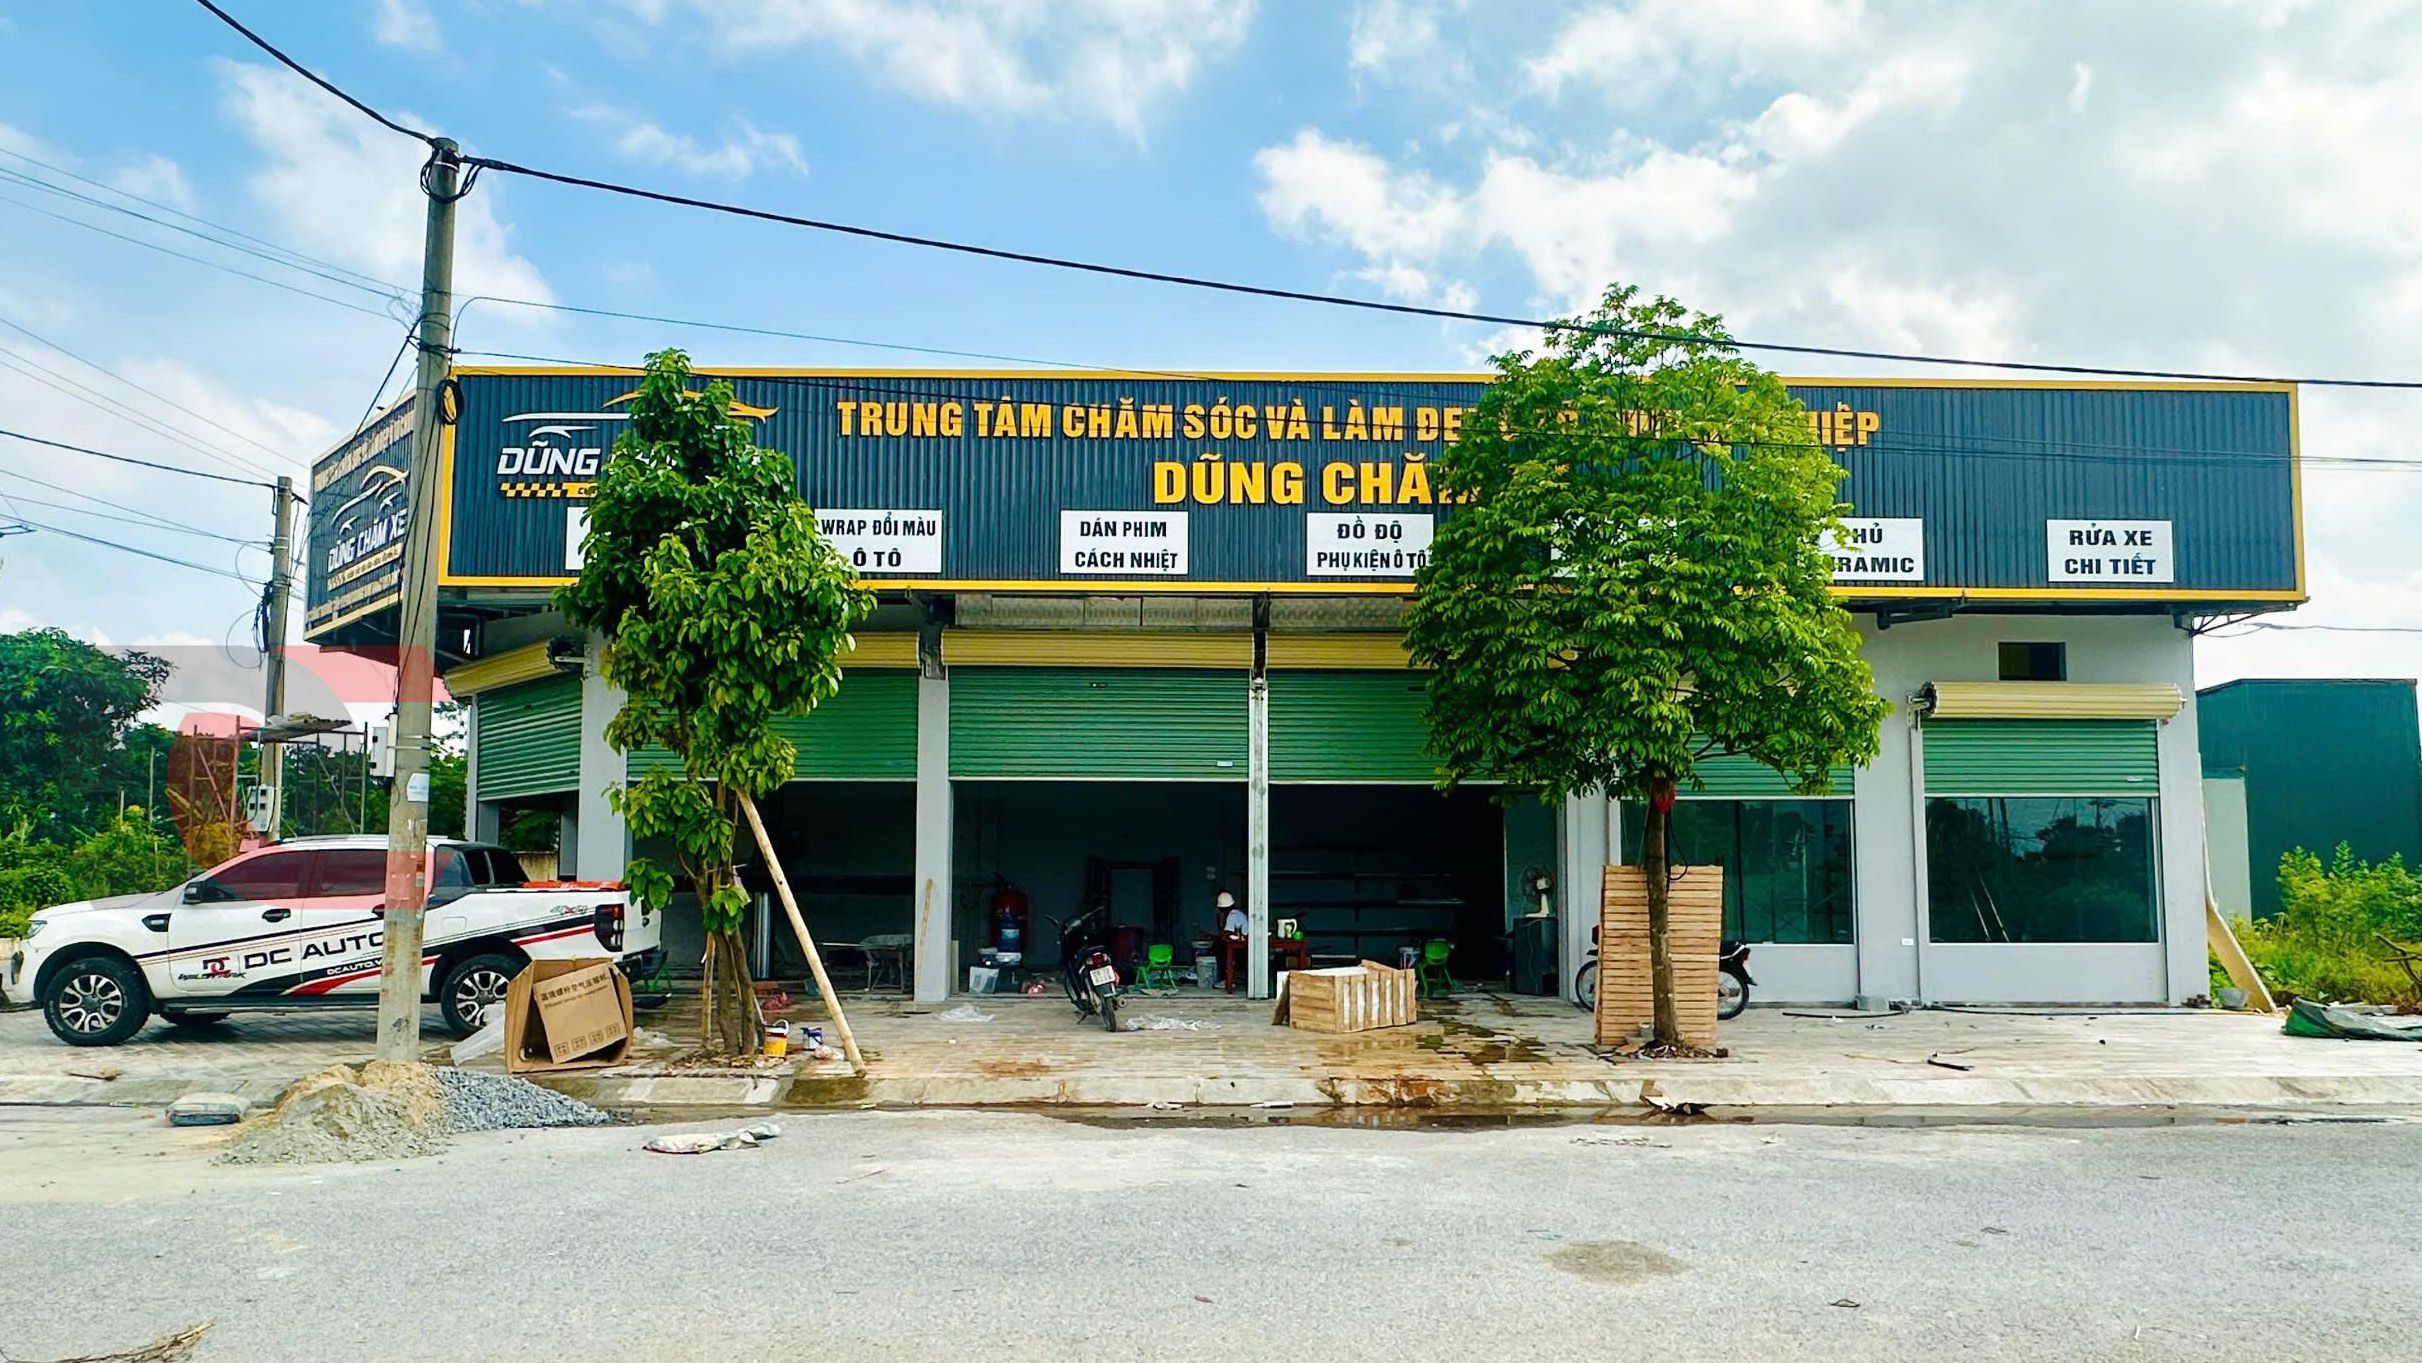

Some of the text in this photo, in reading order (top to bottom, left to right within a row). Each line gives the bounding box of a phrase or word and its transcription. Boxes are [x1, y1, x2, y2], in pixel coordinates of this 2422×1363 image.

[837, 401, 963, 437] TRUNG
[973, 396, 1052, 438] TÂM
[1062, 397, 1174, 439] CHĂM
[1183, 397, 1257, 440] SÓC
[1265, 399, 1310, 440] VÀ
[1323, 399, 1403, 441] LÀM
[497, 440, 600, 475] DŨNG
[1154, 453, 1303, 505] DŨNG
[389, 508, 408, 541] XE
[821, 512, 936, 536] WRAP ĐỔI MÀU
[1080, 517, 1167, 538] DÁN PHIM
[1337, 515, 1402, 543] ĐỒ ĐỘ
[1852, 522, 1882, 543] HỦ
[2069, 523, 2152, 546] RỬA XE
[853, 547, 901, 567] Ô TÔ
[1075, 548, 1178, 572] CÁCH NHIỆT
[1317, 550, 1427, 572] PHỤ KIỆN Ô TÔ
[2064, 552, 2156, 575] CHI TIẾT
[245, 948, 291, 969] DC
[326, 957, 383, 975] DCAUTO.V
